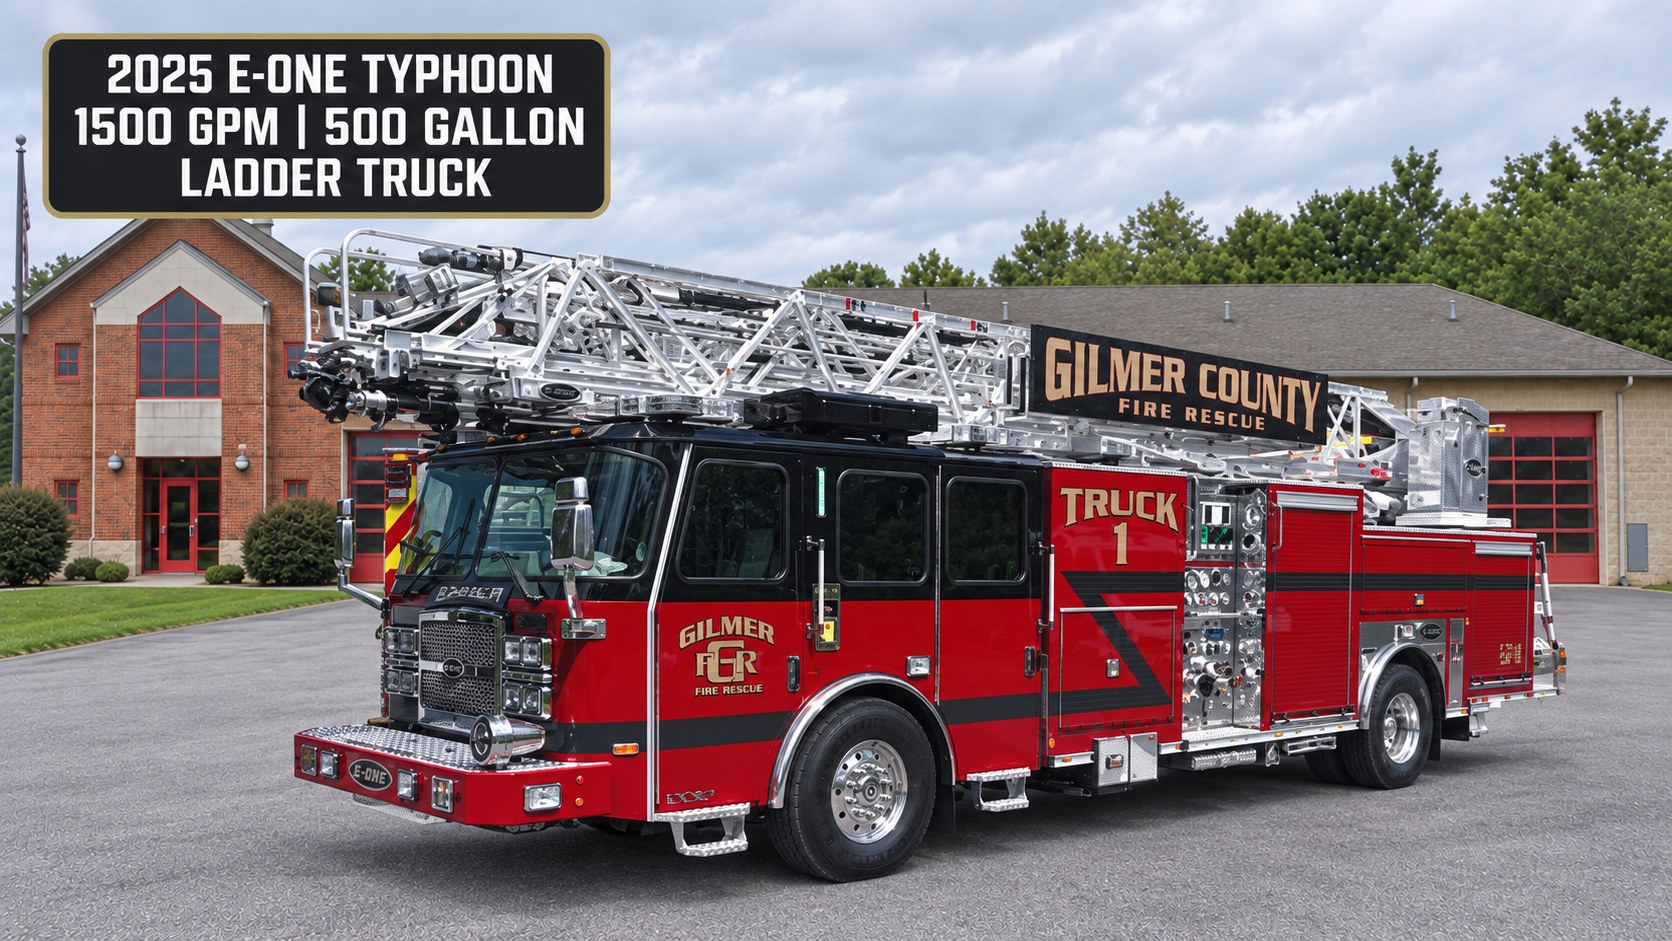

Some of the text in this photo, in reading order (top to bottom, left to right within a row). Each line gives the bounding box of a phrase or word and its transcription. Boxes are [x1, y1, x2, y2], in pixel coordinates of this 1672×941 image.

[1044, 336, 1322, 433] GILMER COUNTY
[1118, 398, 1265, 431] FIRE RESCUE
[1060, 487, 1179, 533] TRUCK
[1113, 521, 1128, 565] 1
[679, 615, 775, 649] GILMER
[695, 684, 763, 696] FIRE RESCUE
